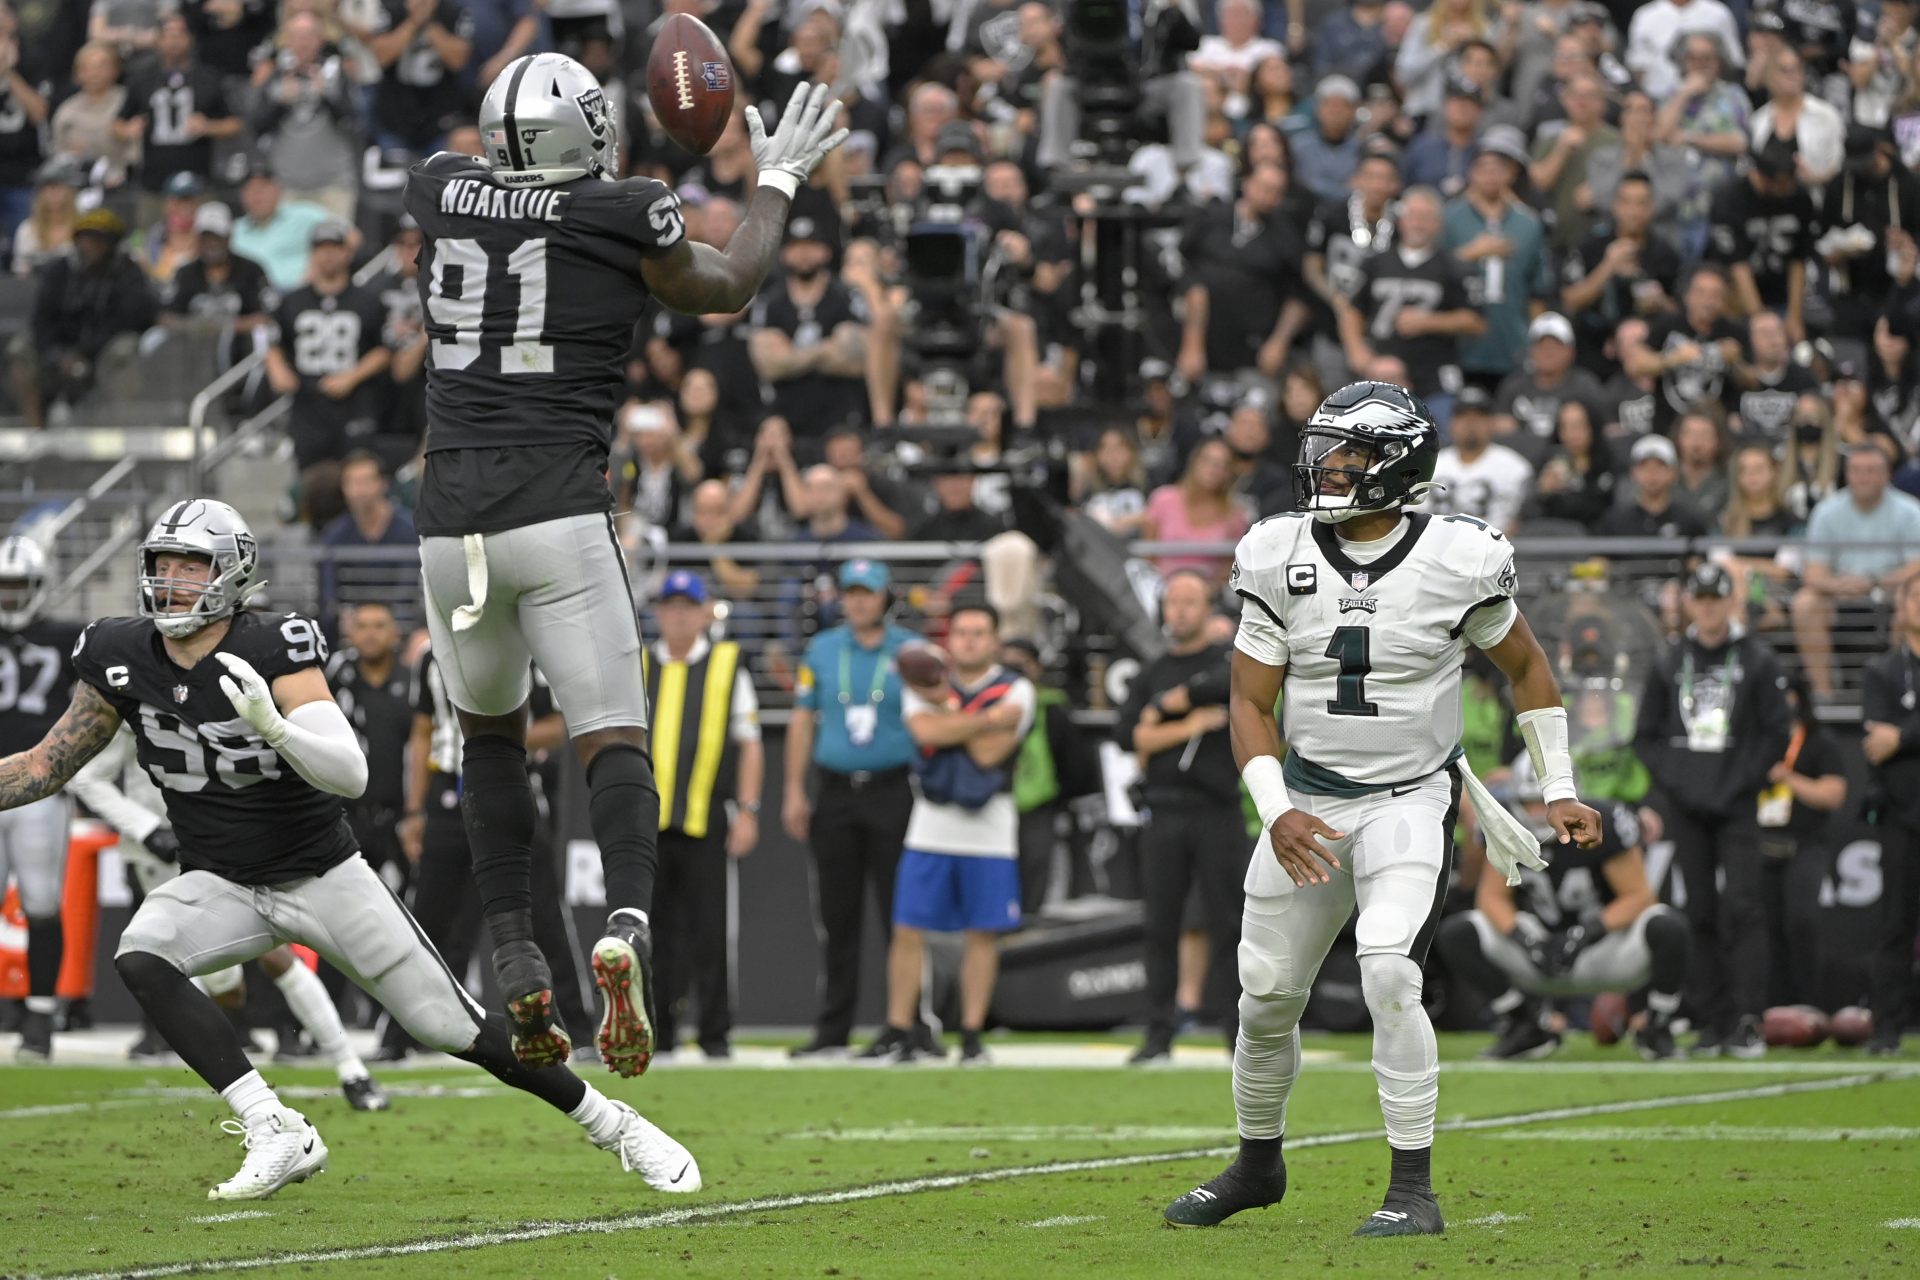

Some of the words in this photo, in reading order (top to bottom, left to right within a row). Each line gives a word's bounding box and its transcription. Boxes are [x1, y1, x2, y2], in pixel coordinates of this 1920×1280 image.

[503, 174, 545, 184] RAIDERS
[427, 237, 554, 374] 91
[294, 310, 361, 376] 28
[1288, 565, 1315, 588] C
[1340, 599, 1377, 613] EAGLES
[105, 665, 130, 687] C
[1324, 626, 1378, 717] 1
[139, 702, 281, 793] 98
